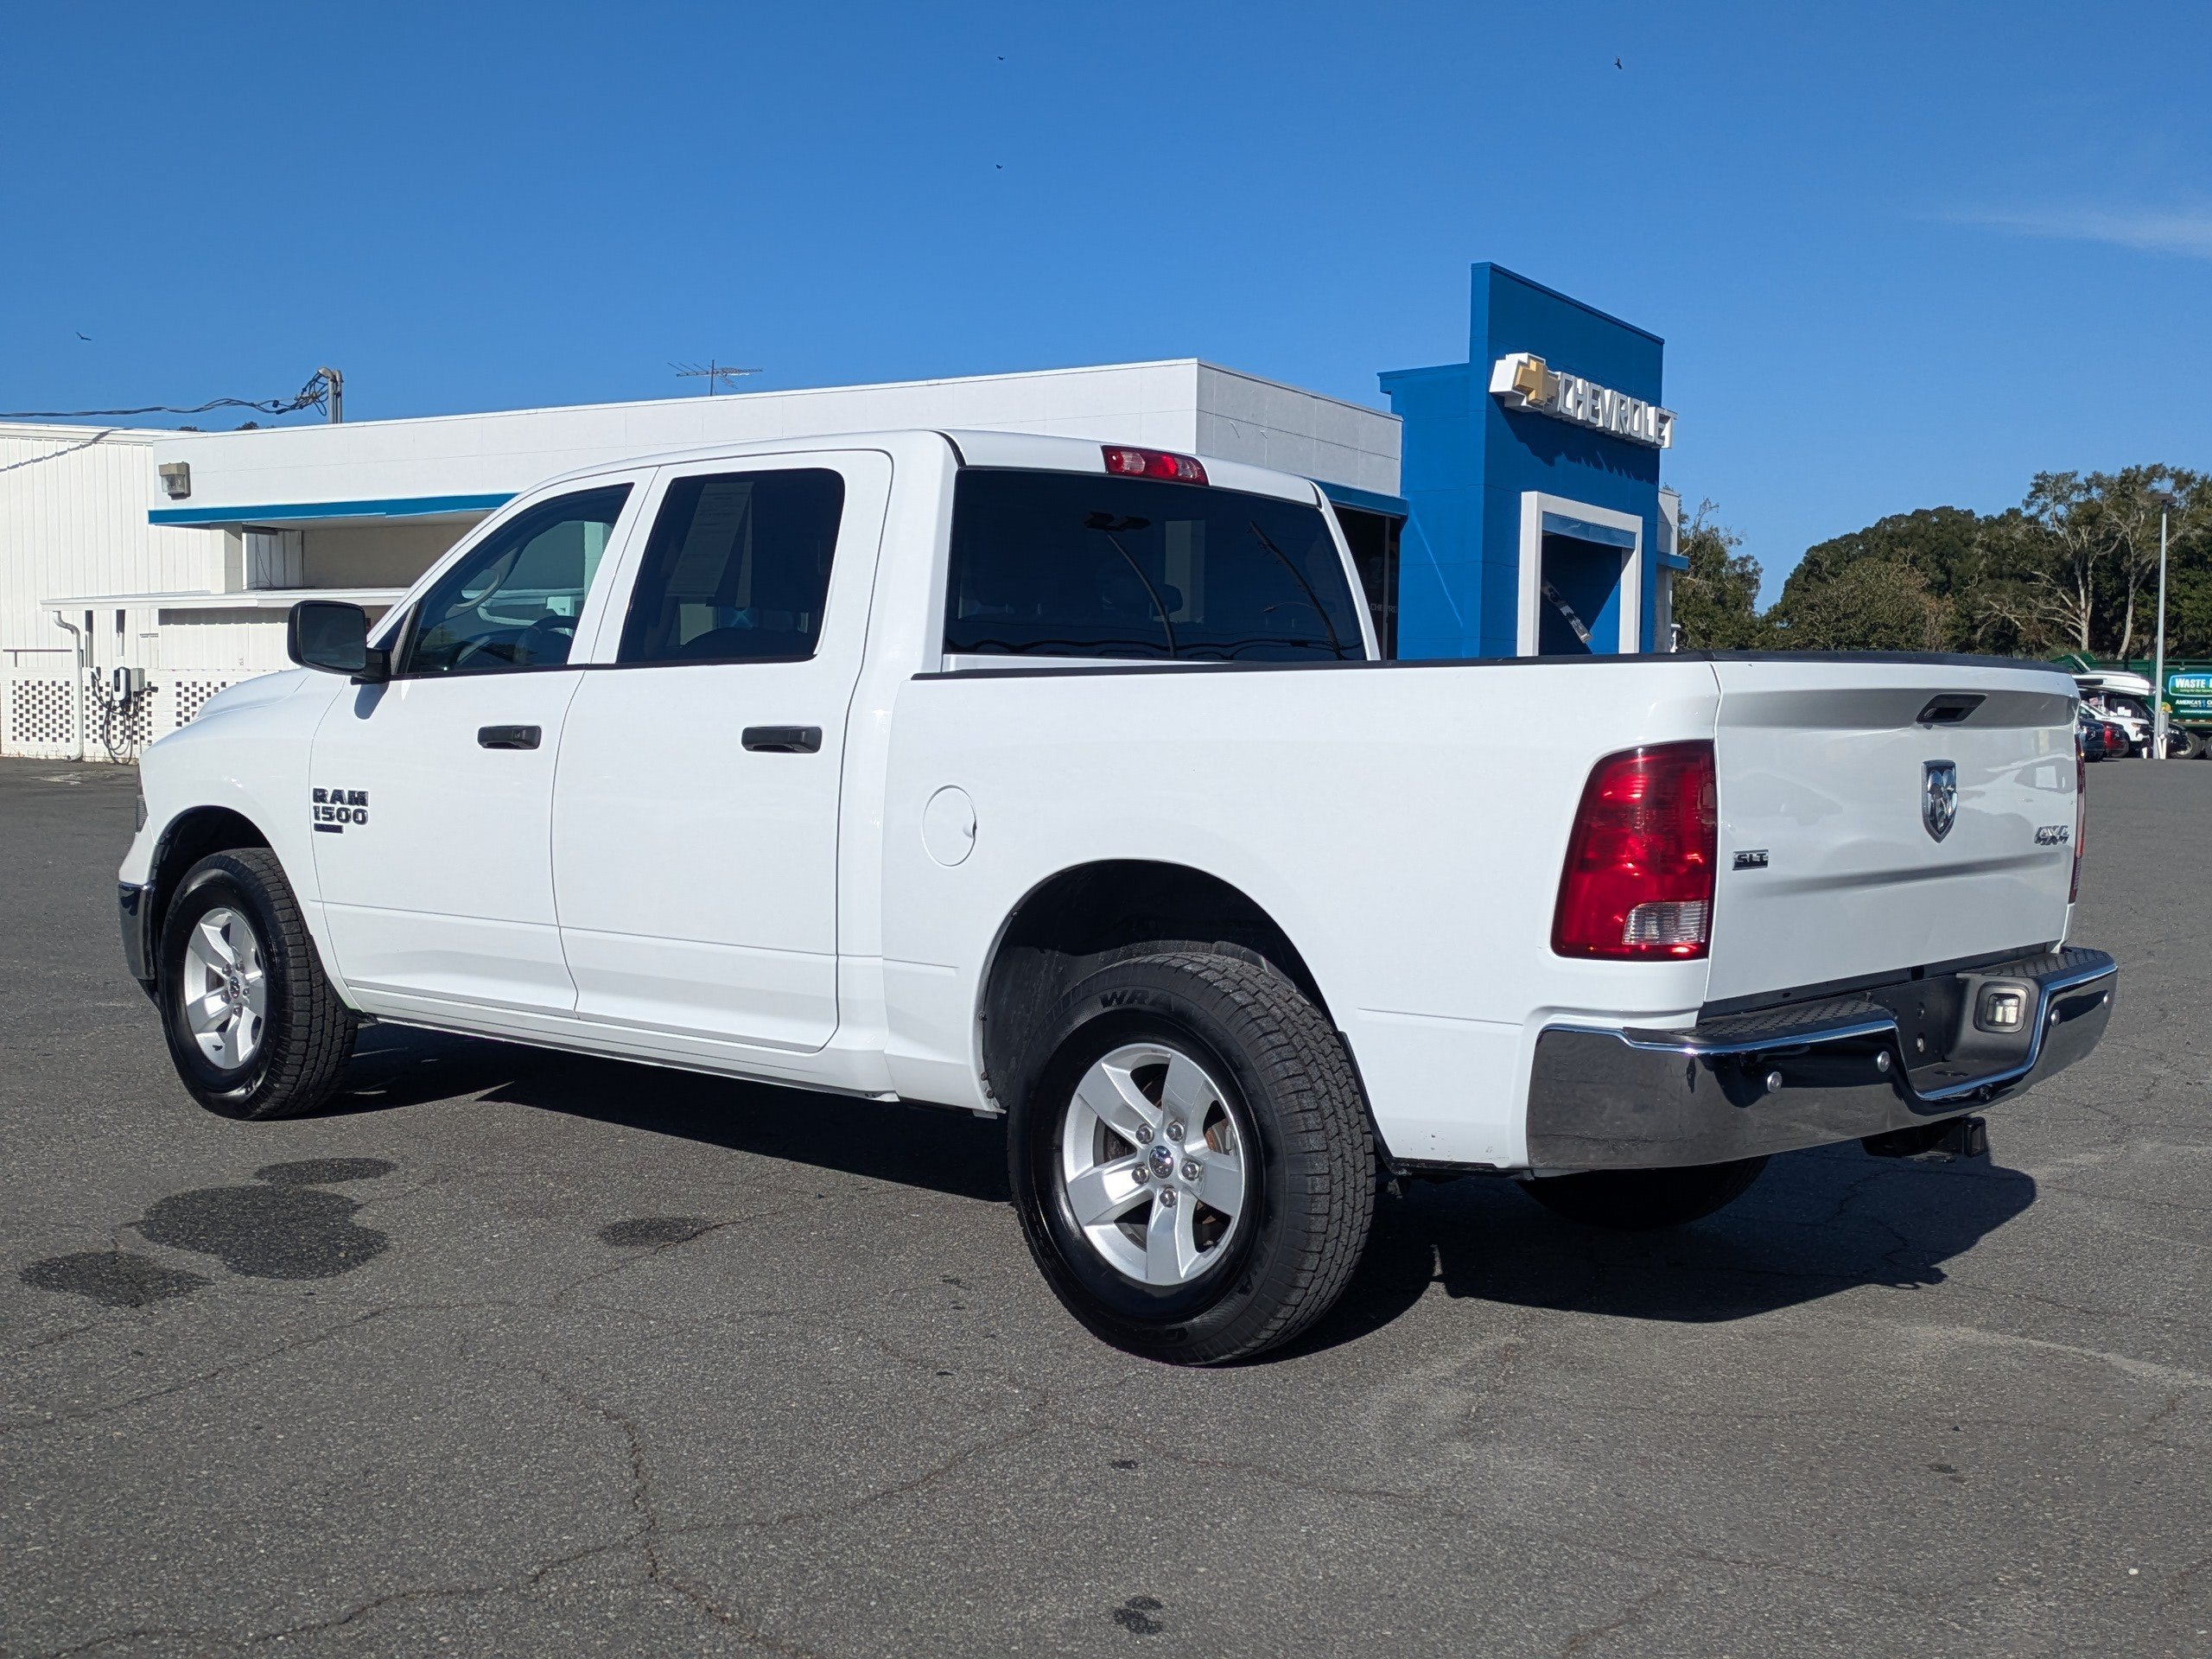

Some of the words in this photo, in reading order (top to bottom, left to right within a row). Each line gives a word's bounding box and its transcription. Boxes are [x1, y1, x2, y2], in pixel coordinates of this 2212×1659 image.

[1558, 372, 1678, 449] CHEVROLET
[2175, 677, 2206, 689] WASTE
[313, 787, 368, 807] RAM
[313, 805, 368, 825] 1500
[1735, 852, 1768, 865] SLT
